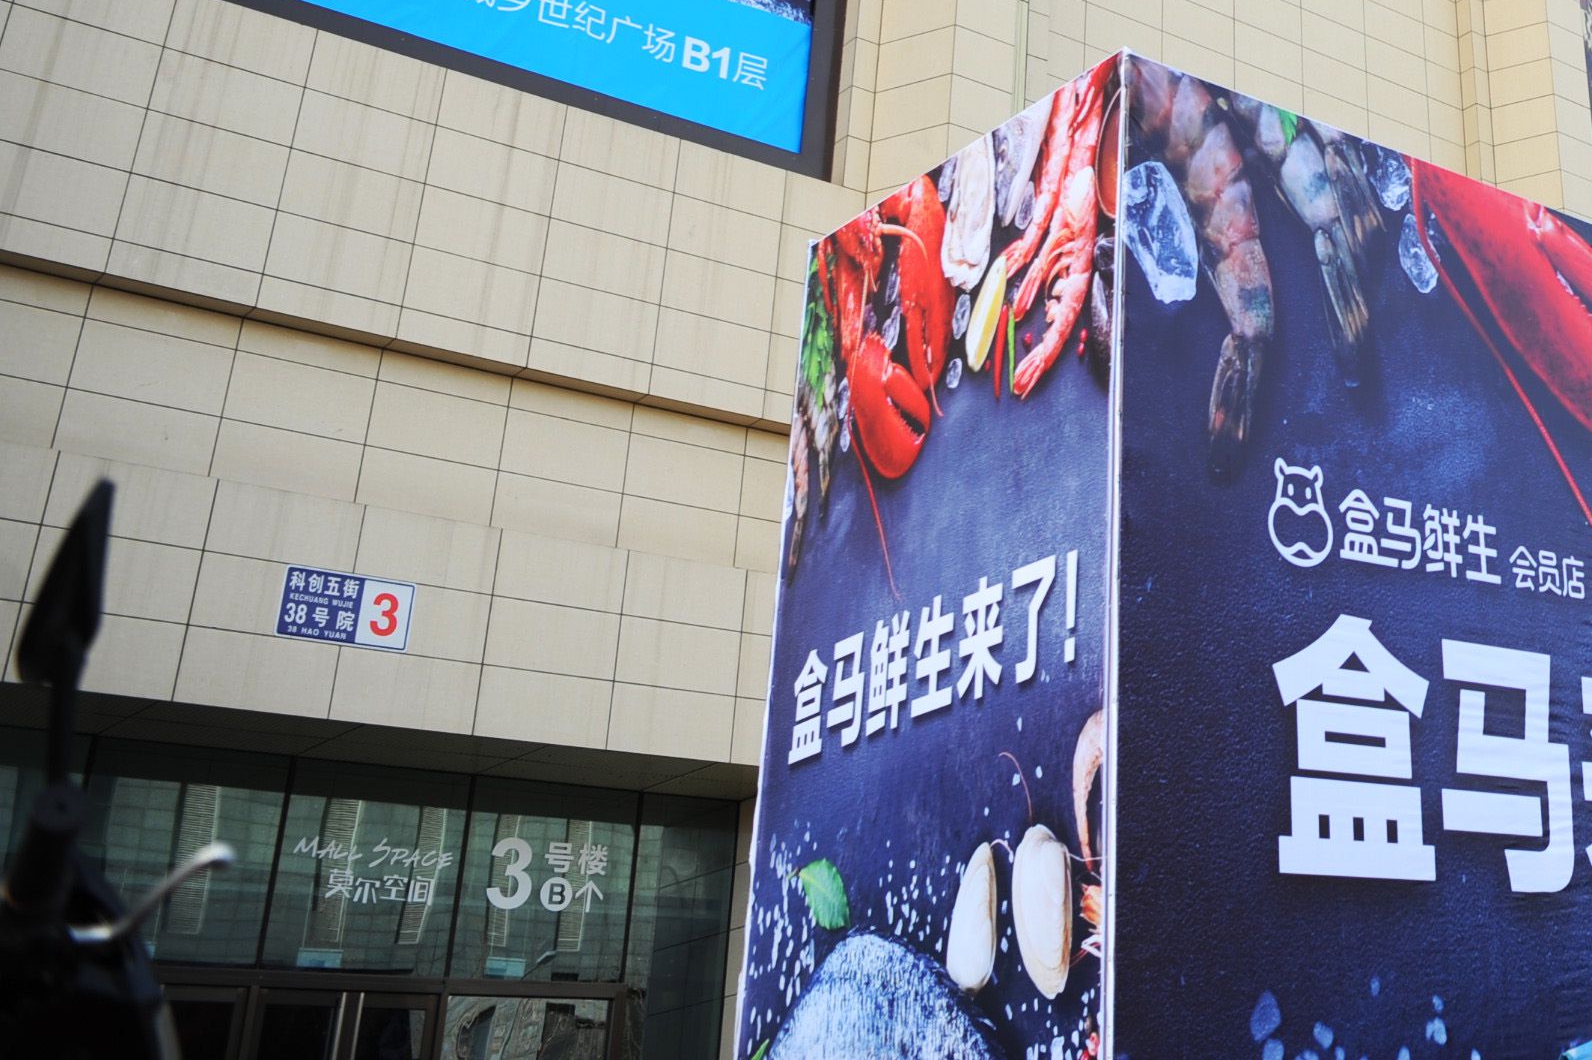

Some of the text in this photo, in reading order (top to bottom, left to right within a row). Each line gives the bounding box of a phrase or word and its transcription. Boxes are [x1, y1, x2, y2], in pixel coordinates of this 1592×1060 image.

[1339, 489, 1586, 600] 盒马鲜生 会员店
[288, 571, 360, 599] 科创五街
[289, 592, 354, 609] KECHUANG WUJIE
[369, 592, 399, 637] 3
[287, 624, 347, 640] 38 HAO YUAN
[324, 868, 436, 907] 莫尔空间
